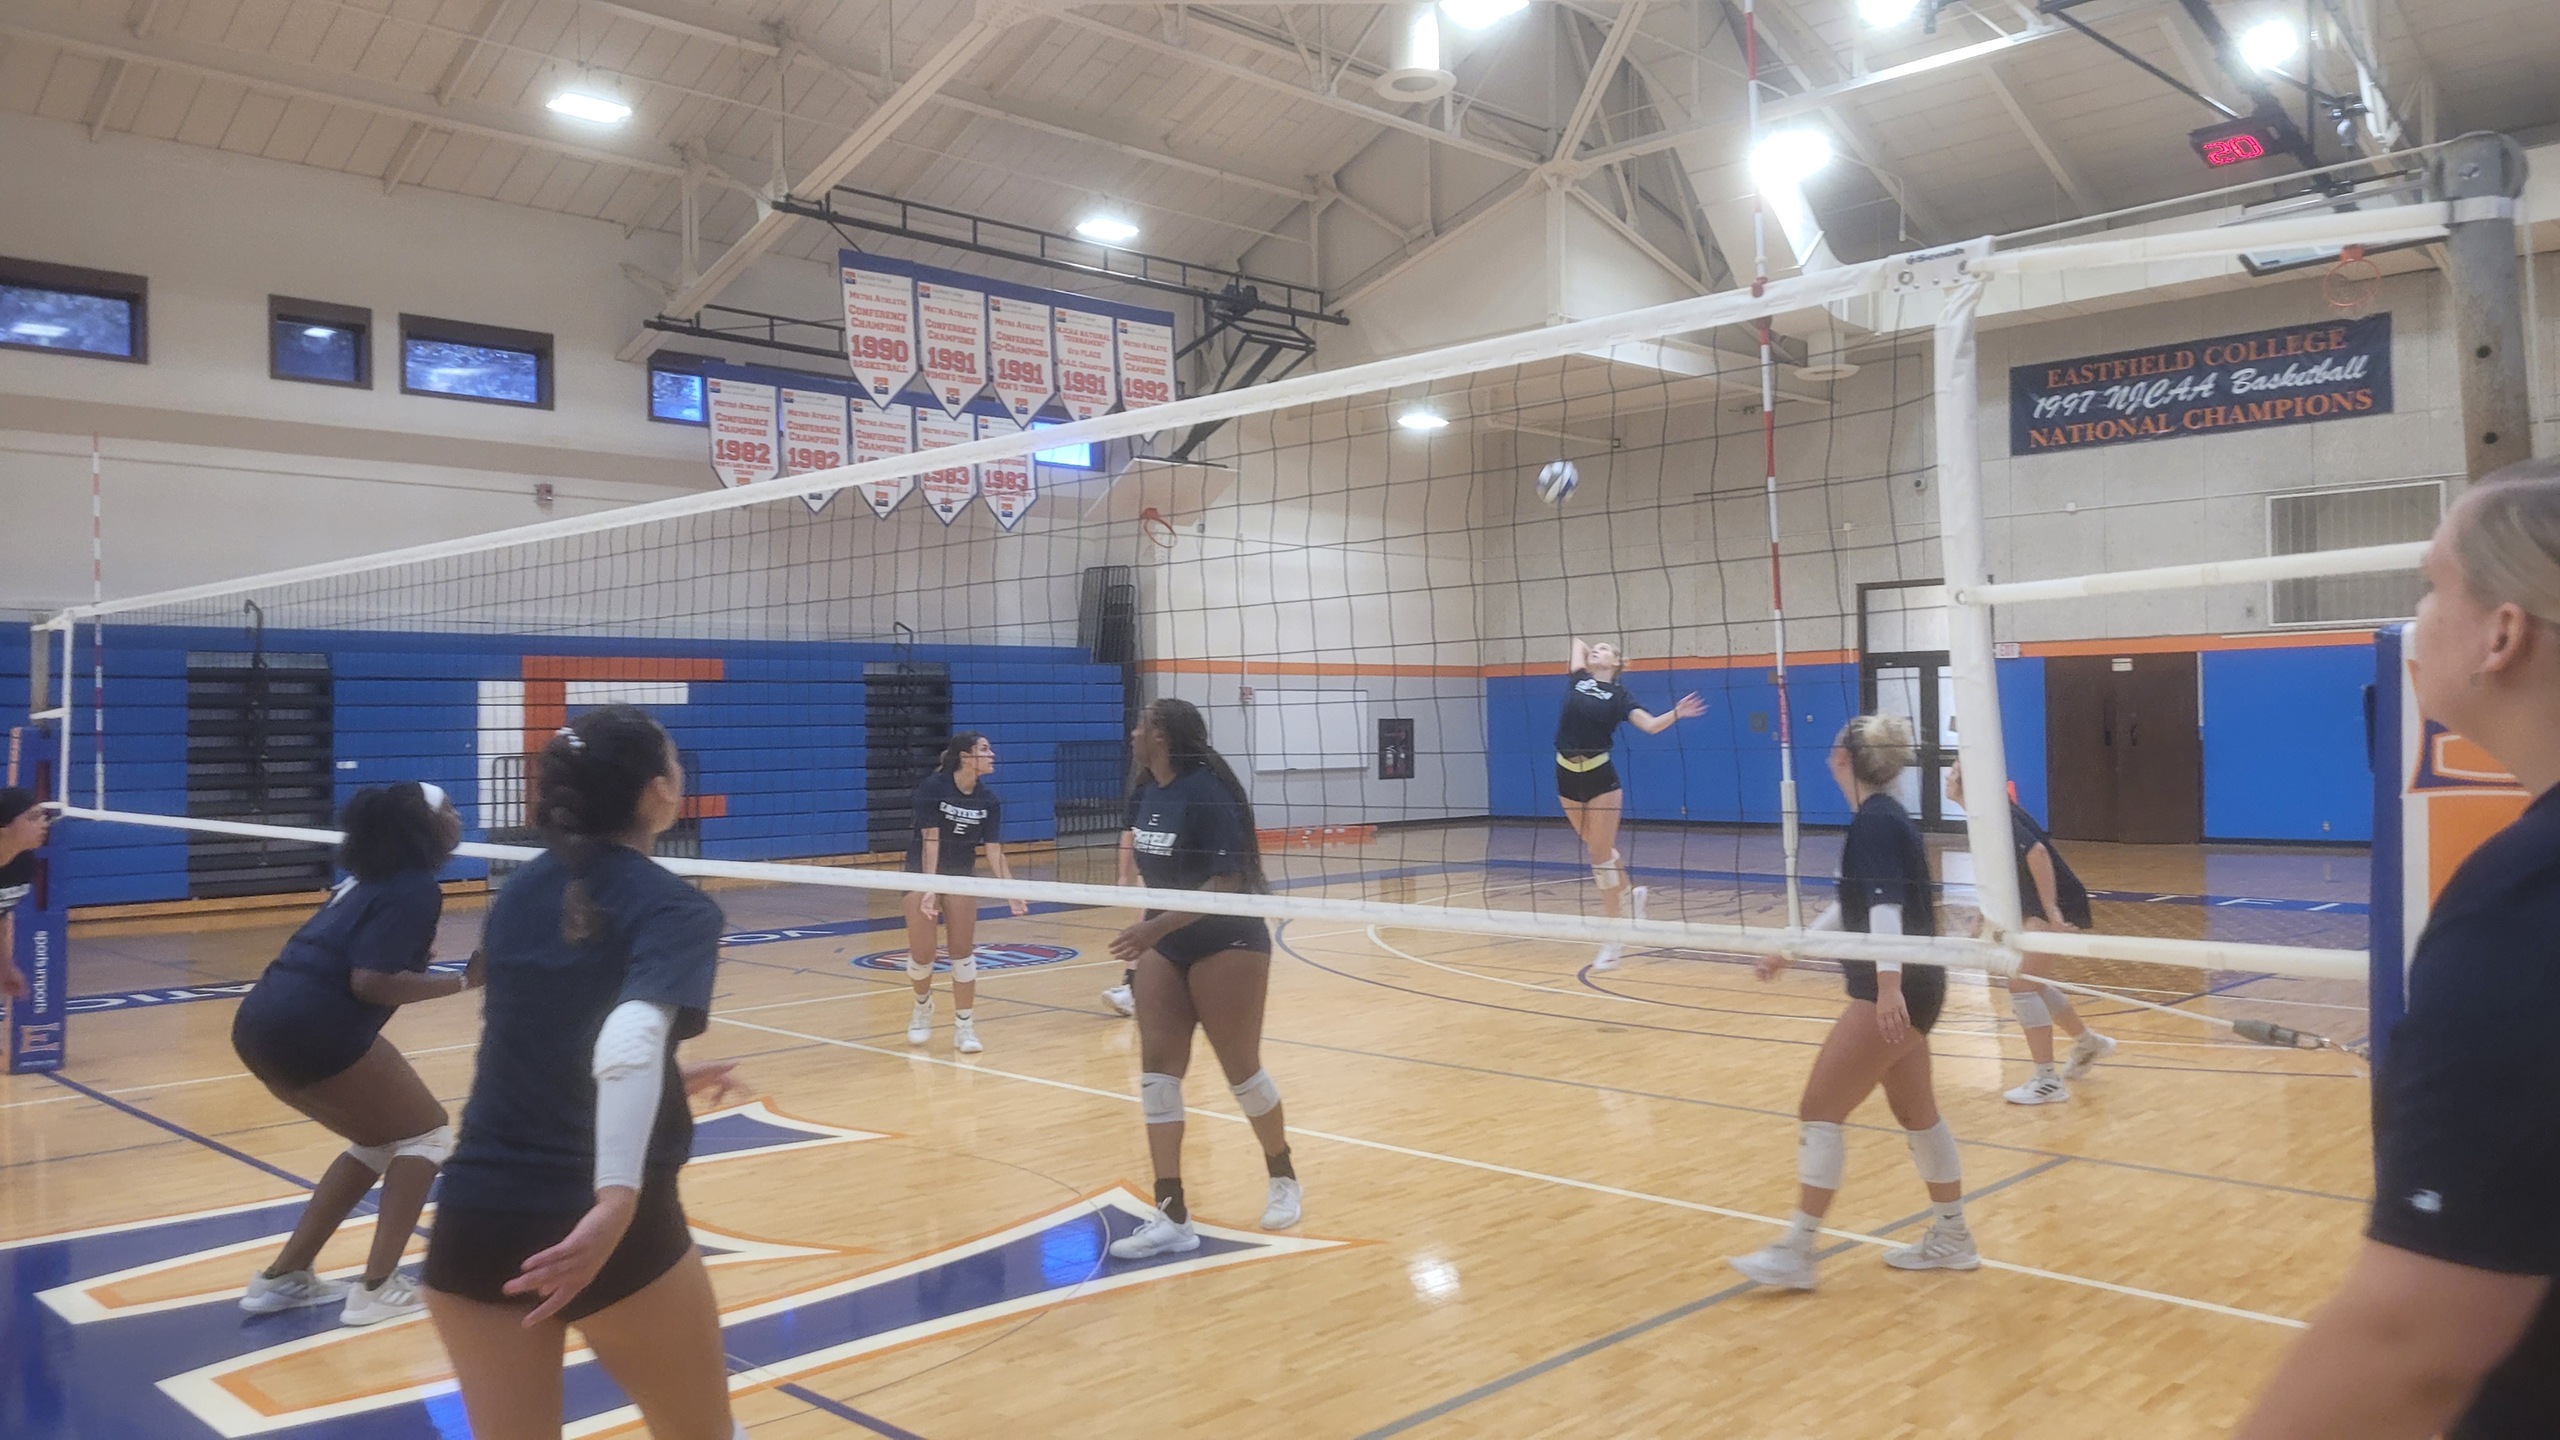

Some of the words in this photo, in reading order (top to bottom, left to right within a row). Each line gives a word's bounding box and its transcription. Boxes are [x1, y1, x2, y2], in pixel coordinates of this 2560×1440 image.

[2203, 134, 2264, 166] 20
[848, 304, 907, 322] CONFERENCE
[851, 317, 906, 334] CHAMPIONS
[925, 318, 977, 335] CONFERENCE
[927, 329, 976, 346] CHAMPIONS
[996, 331, 1044, 347] CONFERENCE
[852, 334, 909, 363] 1990
[991, 341, 1049, 358] CO-CHAMPIONS
[2047, 350, 2195, 389] EASTFIELD
[2204, 327, 2347, 366] COLLEGE
[928, 346, 976, 374] 1991
[997, 358, 1044, 385] 1991
[1063, 370, 1107, 396] 1991
[1124, 377, 1168, 402] 1992
[2031, 390, 2096, 419] 1997
[2103, 372, 2218, 415] NJCAA
[2230, 354, 2369, 395] Basketball
[715, 412, 769, 427] CONFERENCE
[787, 420, 841, 435] CONFERENCE
[2029, 413, 2177, 448] NATIONAL
[2183, 387, 2372, 430] CHAMPIONS
[717, 423, 767, 437] CHAMPIONS
[788, 431, 839, 446] CHAMPIONS
[855, 429, 907, 444] CONFERENCE
[715, 438, 771, 464] 1982
[857, 440, 904, 454] CHAMPIONS
[788, 447, 840, 470] 1982
[984, 469, 1028, 491] 1983
